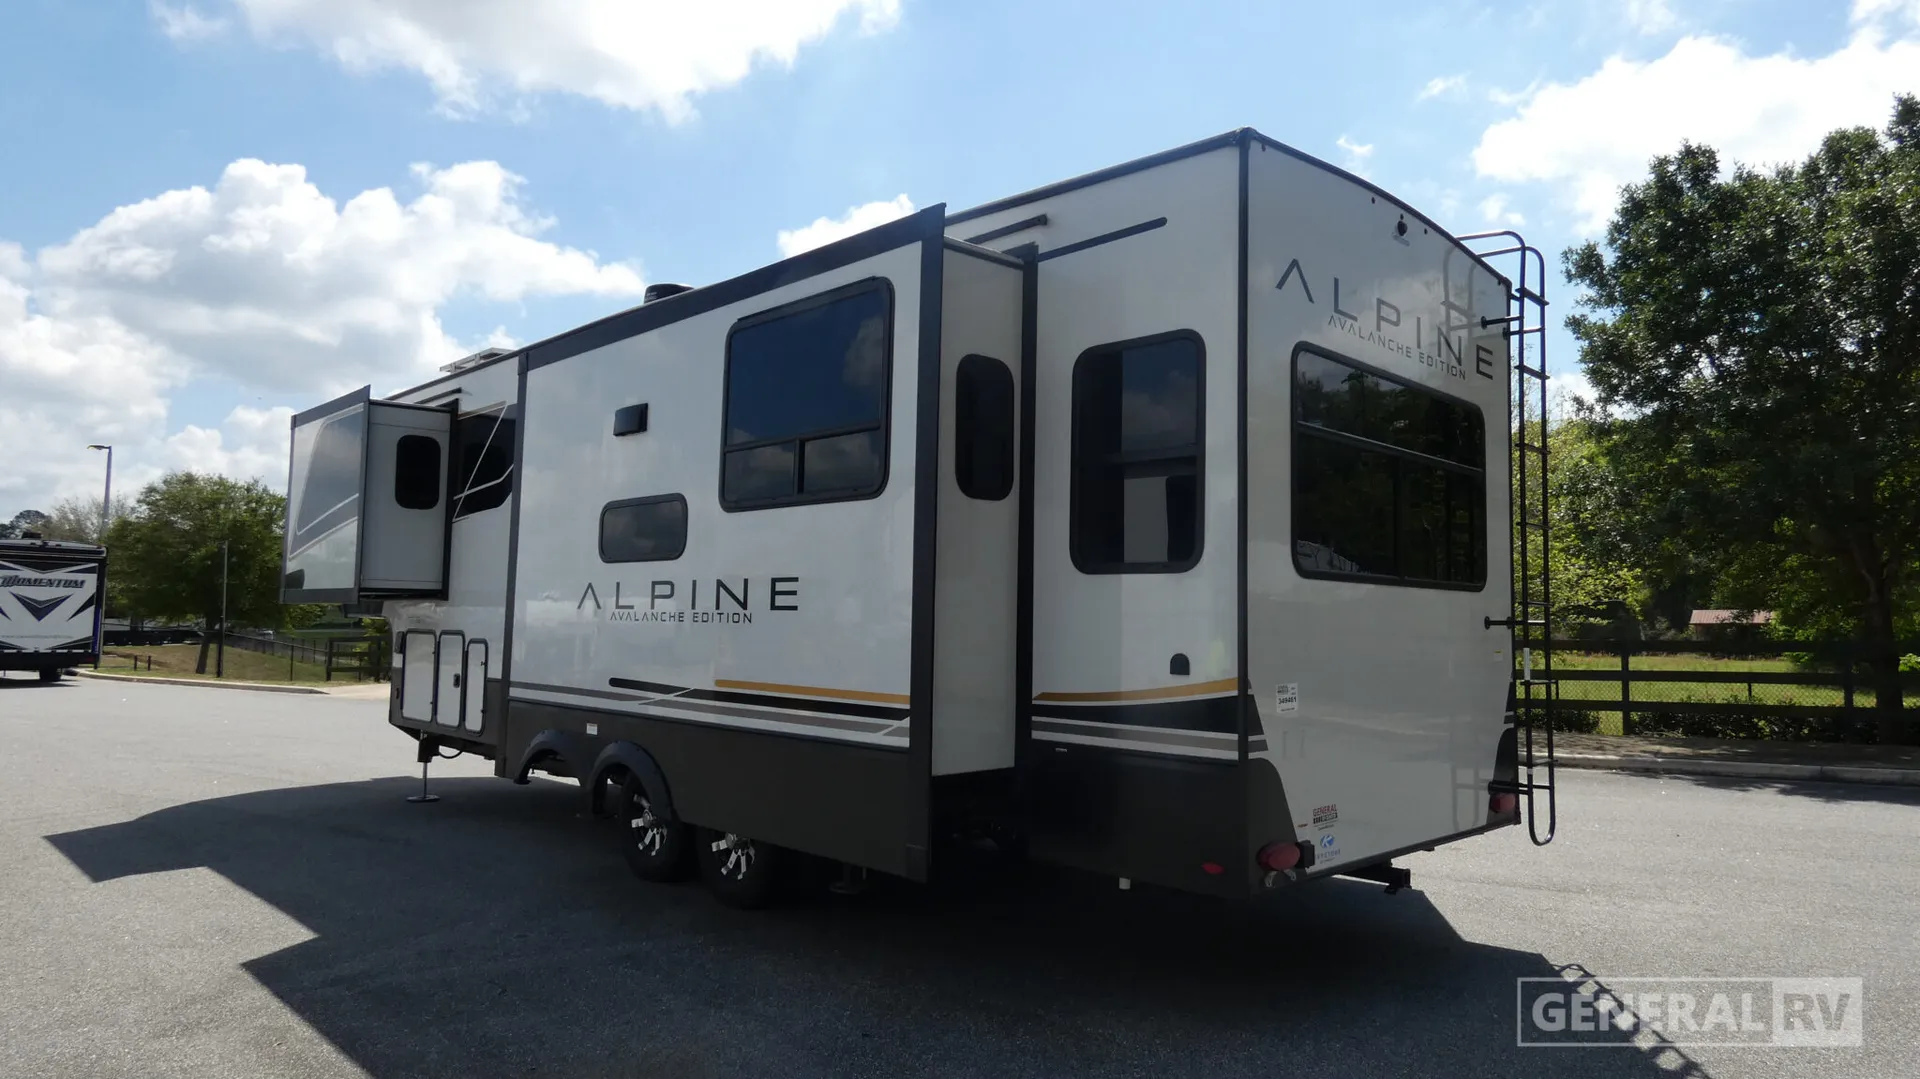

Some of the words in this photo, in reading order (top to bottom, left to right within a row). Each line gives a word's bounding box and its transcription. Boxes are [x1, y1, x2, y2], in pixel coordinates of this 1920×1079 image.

[1275, 258, 1494, 381] ALPINE
[1328, 314, 1413, 359] AVALANCHE
[1418, 351, 1467, 382] EDITION
[0, 575, 86, 589] MOMENTUM
[577, 577, 799, 611] ALPINE
[610, 611, 685, 623] AVALANCHE
[692, 612, 753, 624] EDITION
